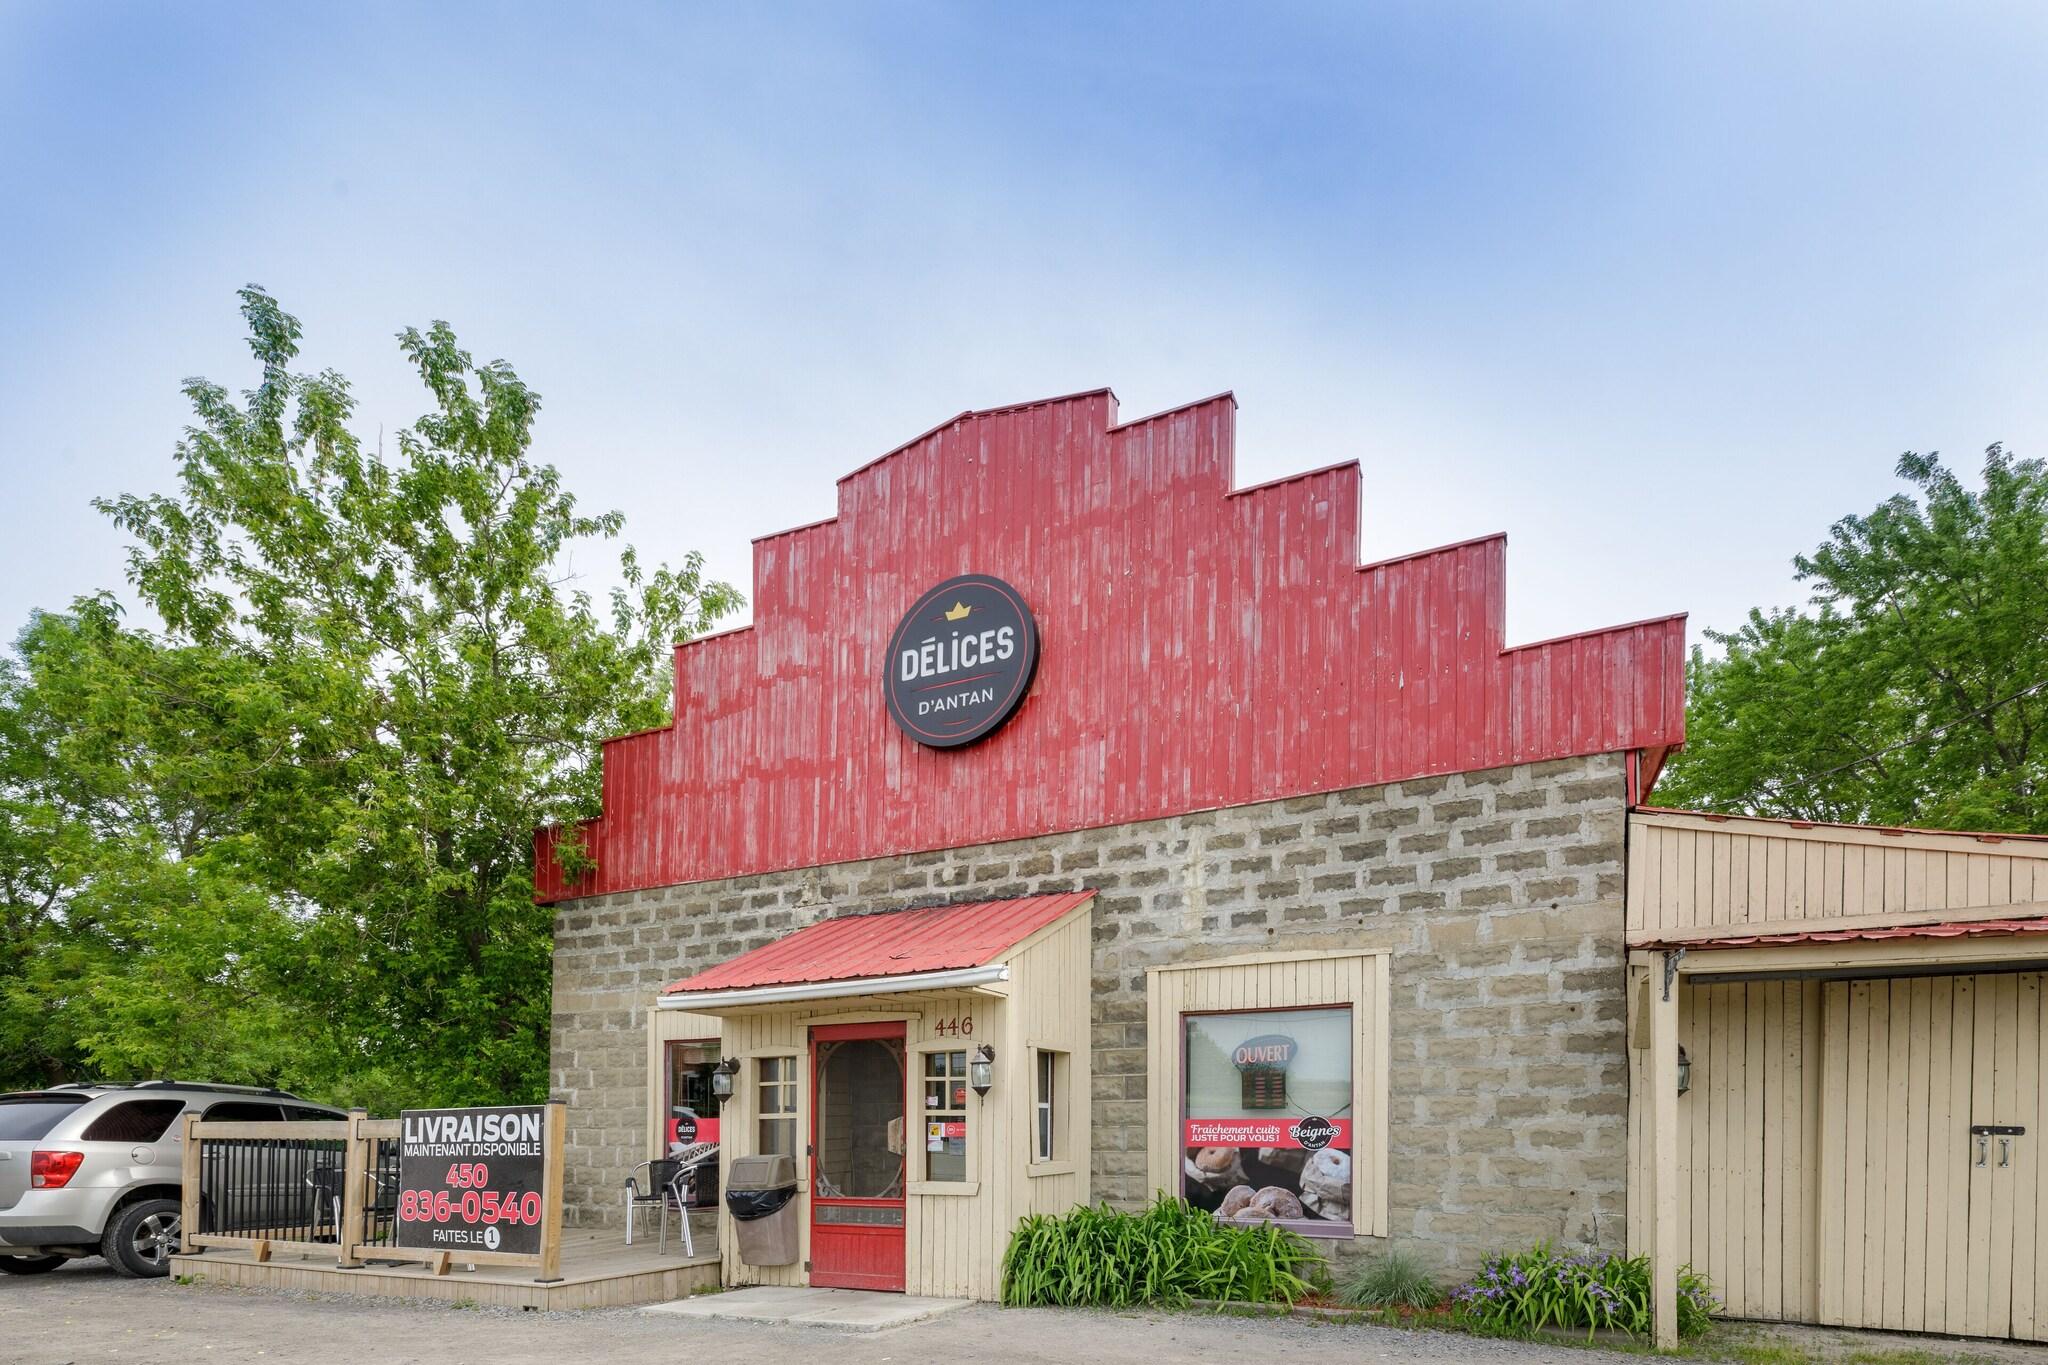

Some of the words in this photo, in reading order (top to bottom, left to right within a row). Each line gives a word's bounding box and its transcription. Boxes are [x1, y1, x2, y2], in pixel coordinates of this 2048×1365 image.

[918, 687, 994, 716] D'ANTAN
[935, 1016, 973, 1036] 446
[1236, 1044, 1290, 1064] OUVERT
[404, 1113, 540, 1144] LIVRAISON
[1191, 1134, 1218, 1142] JUSTE
[1220, 1134, 1247, 1142] POUR
[1255, 1125, 1281, 1135] cuits
[1290, 1126, 1340, 1141] Beignes
[404, 1143, 472, 1157] MAINTENANT
[473, 1142, 541, 1156] DISPONIBLE
[445, 1162, 489, 1189] 450
[400, 1189, 542, 1226] 836-0540
[433, 1229, 468, 1243] FAITES
[470, 1230, 484, 1244] LE
